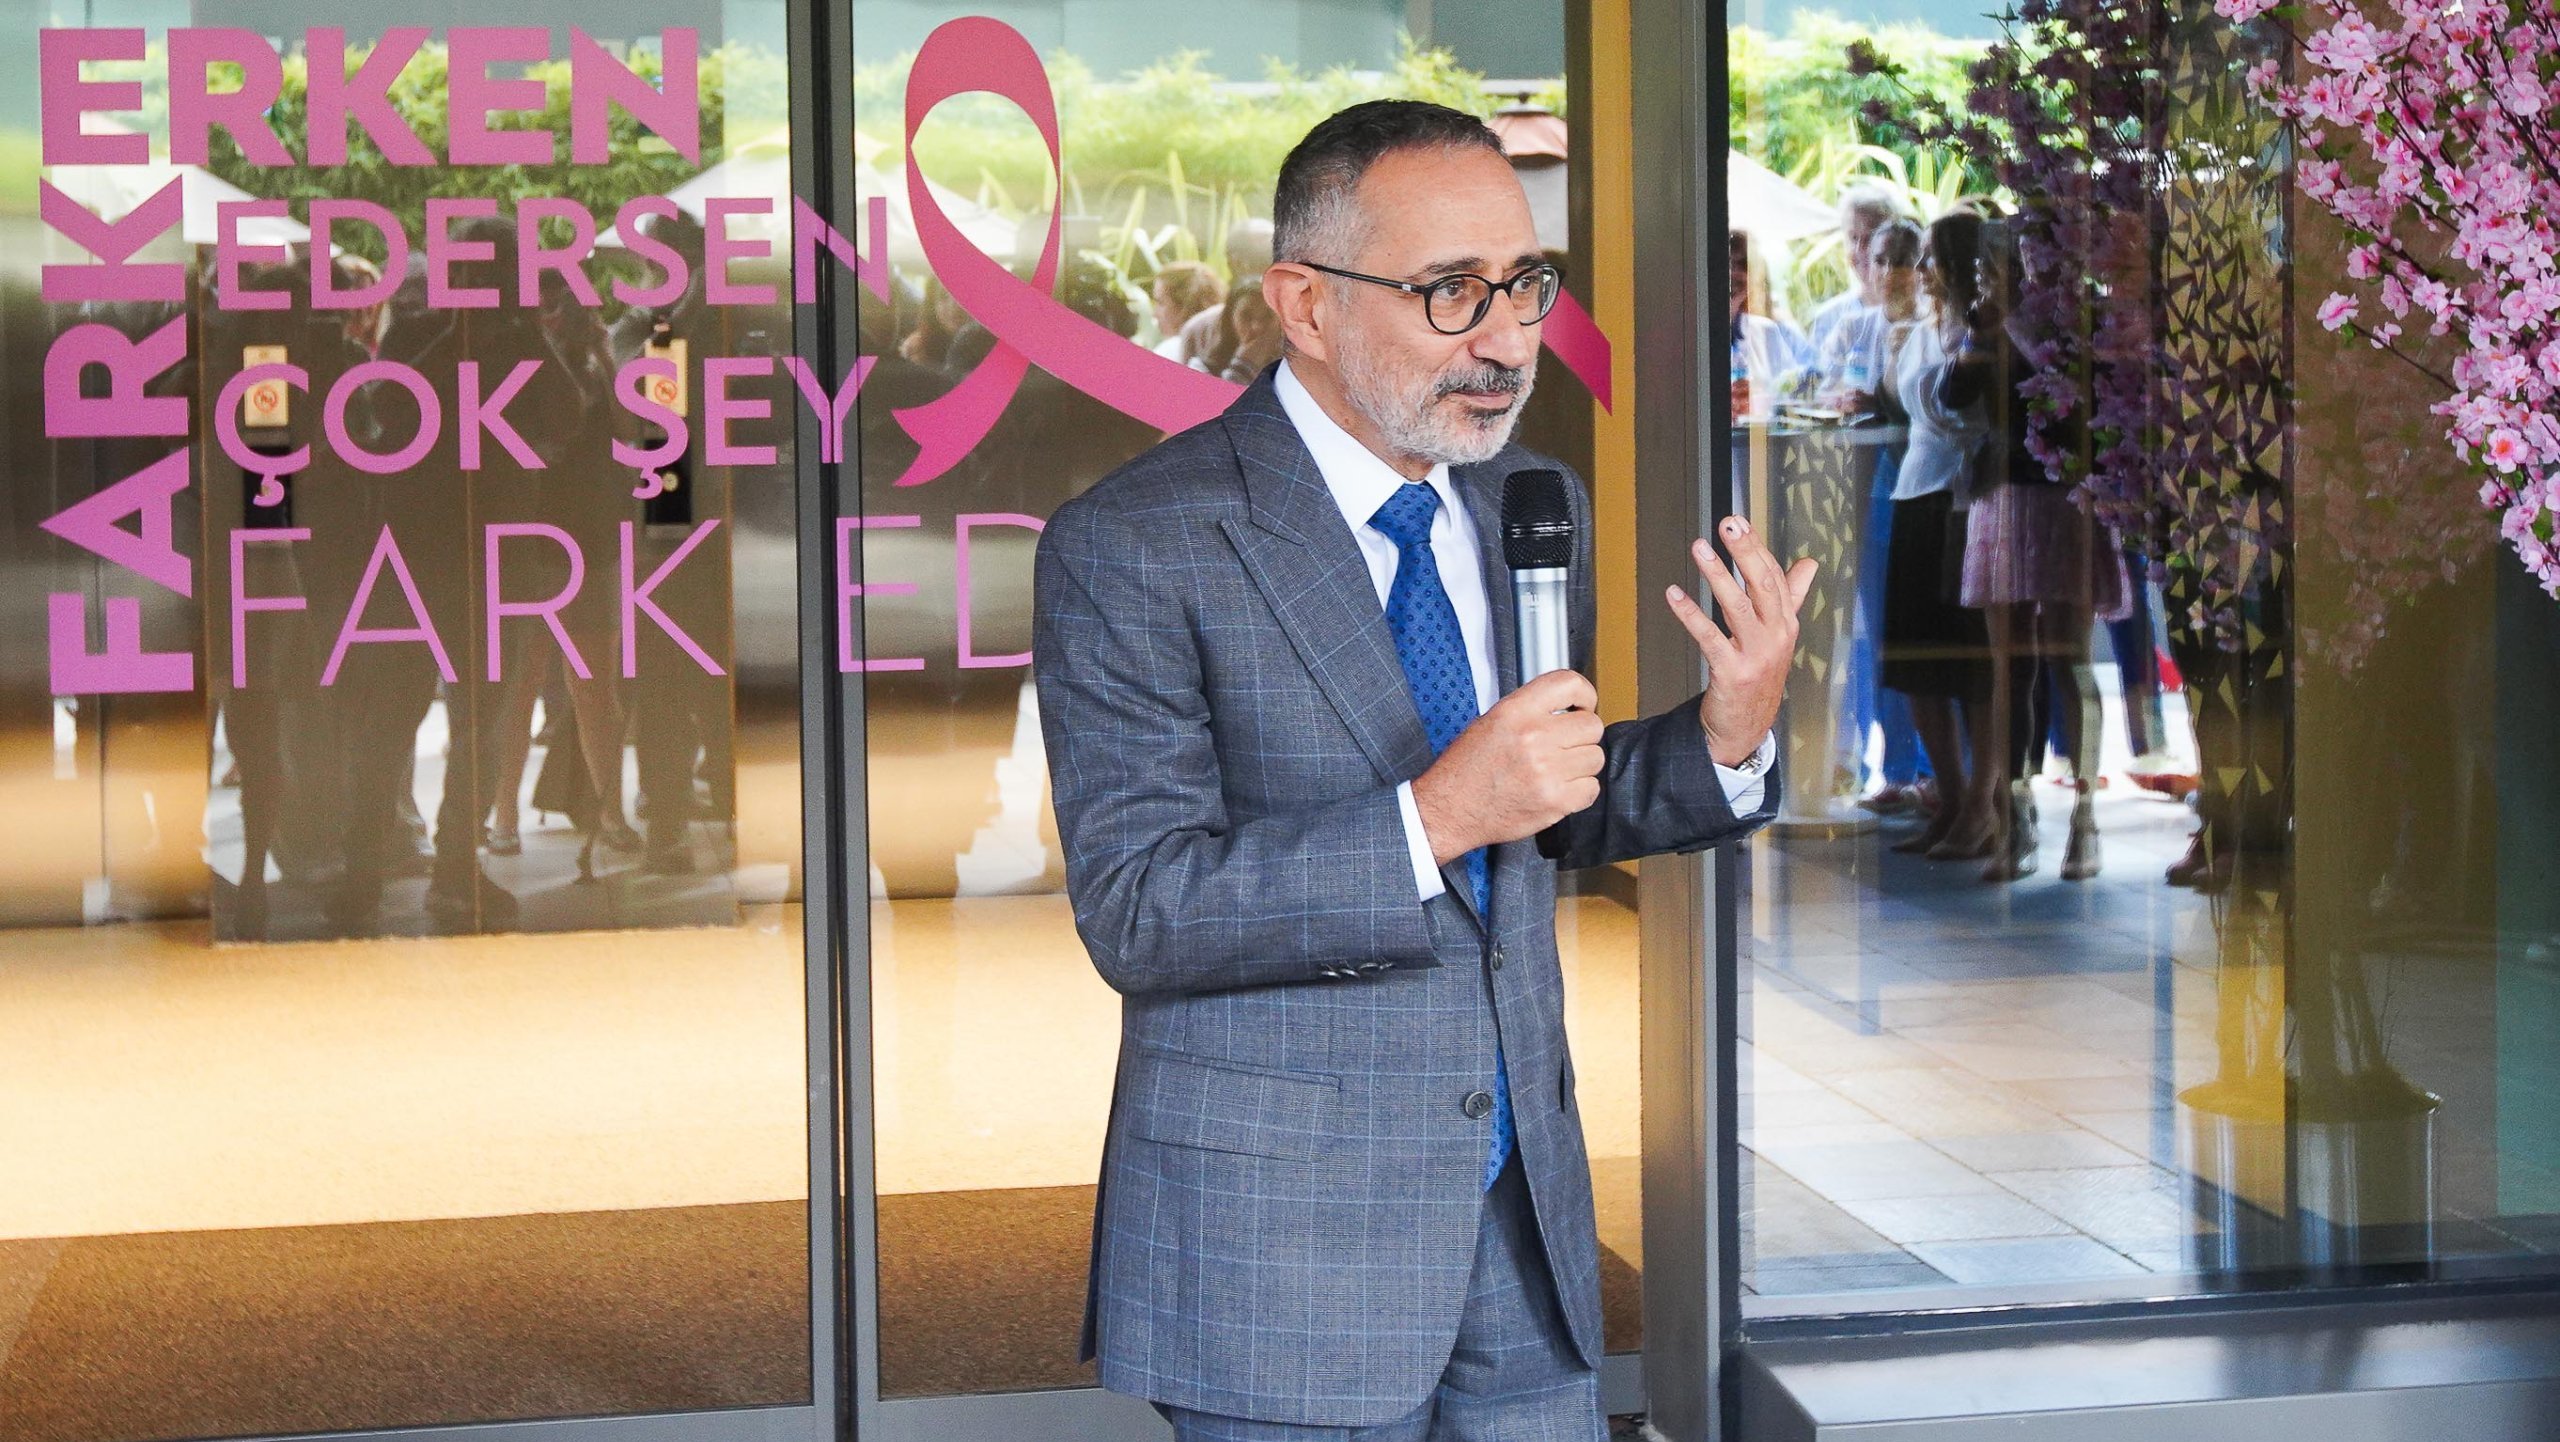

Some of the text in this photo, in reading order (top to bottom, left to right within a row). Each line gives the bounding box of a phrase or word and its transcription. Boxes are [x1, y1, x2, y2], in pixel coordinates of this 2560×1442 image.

[40, 27, 700, 166] ERKEN
[216, 196, 891, 310] EDERSEN
[39, 173, 194, 696] FARK
[214, 355, 878, 507] ÇOK ŞEY
[230, 518, 727, 688] FARK
